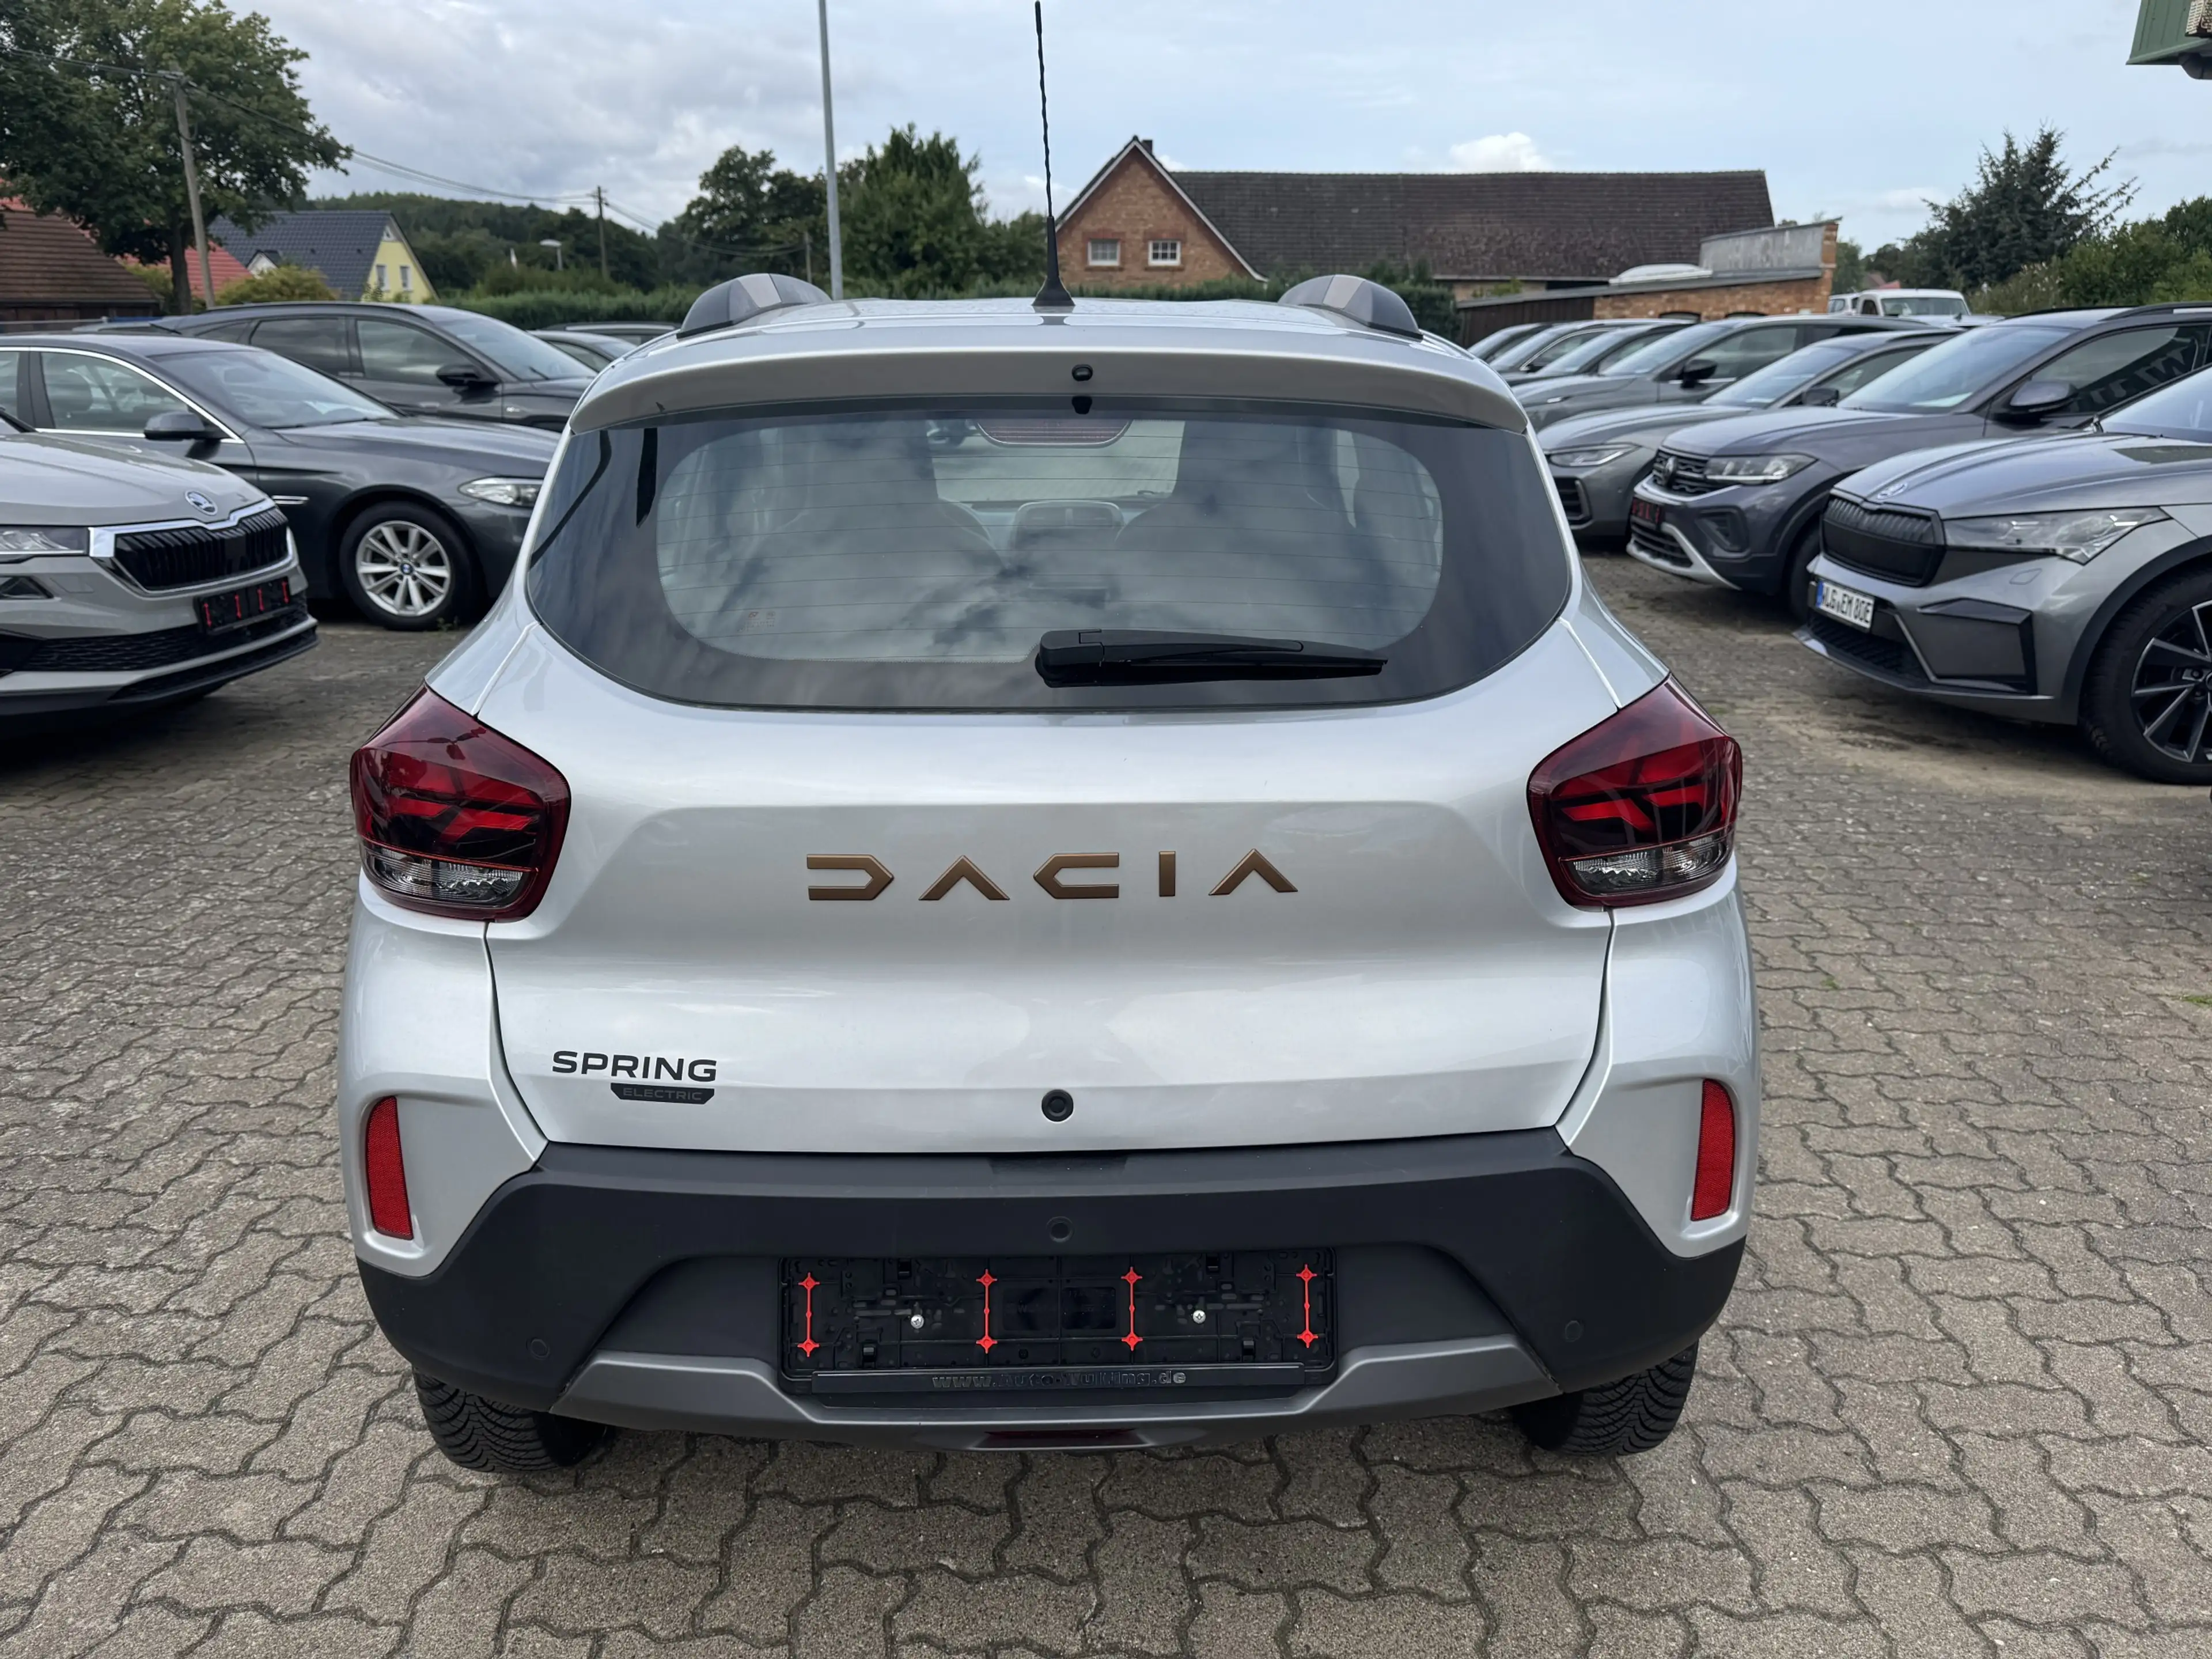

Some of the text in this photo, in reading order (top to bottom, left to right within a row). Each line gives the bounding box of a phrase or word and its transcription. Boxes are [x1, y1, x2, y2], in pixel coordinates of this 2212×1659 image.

[806, 849, 1298, 900] DACIA
[552, 1050, 717, 1082] SPRING
[623, 1087, 702, 1101] ELECTRIC
